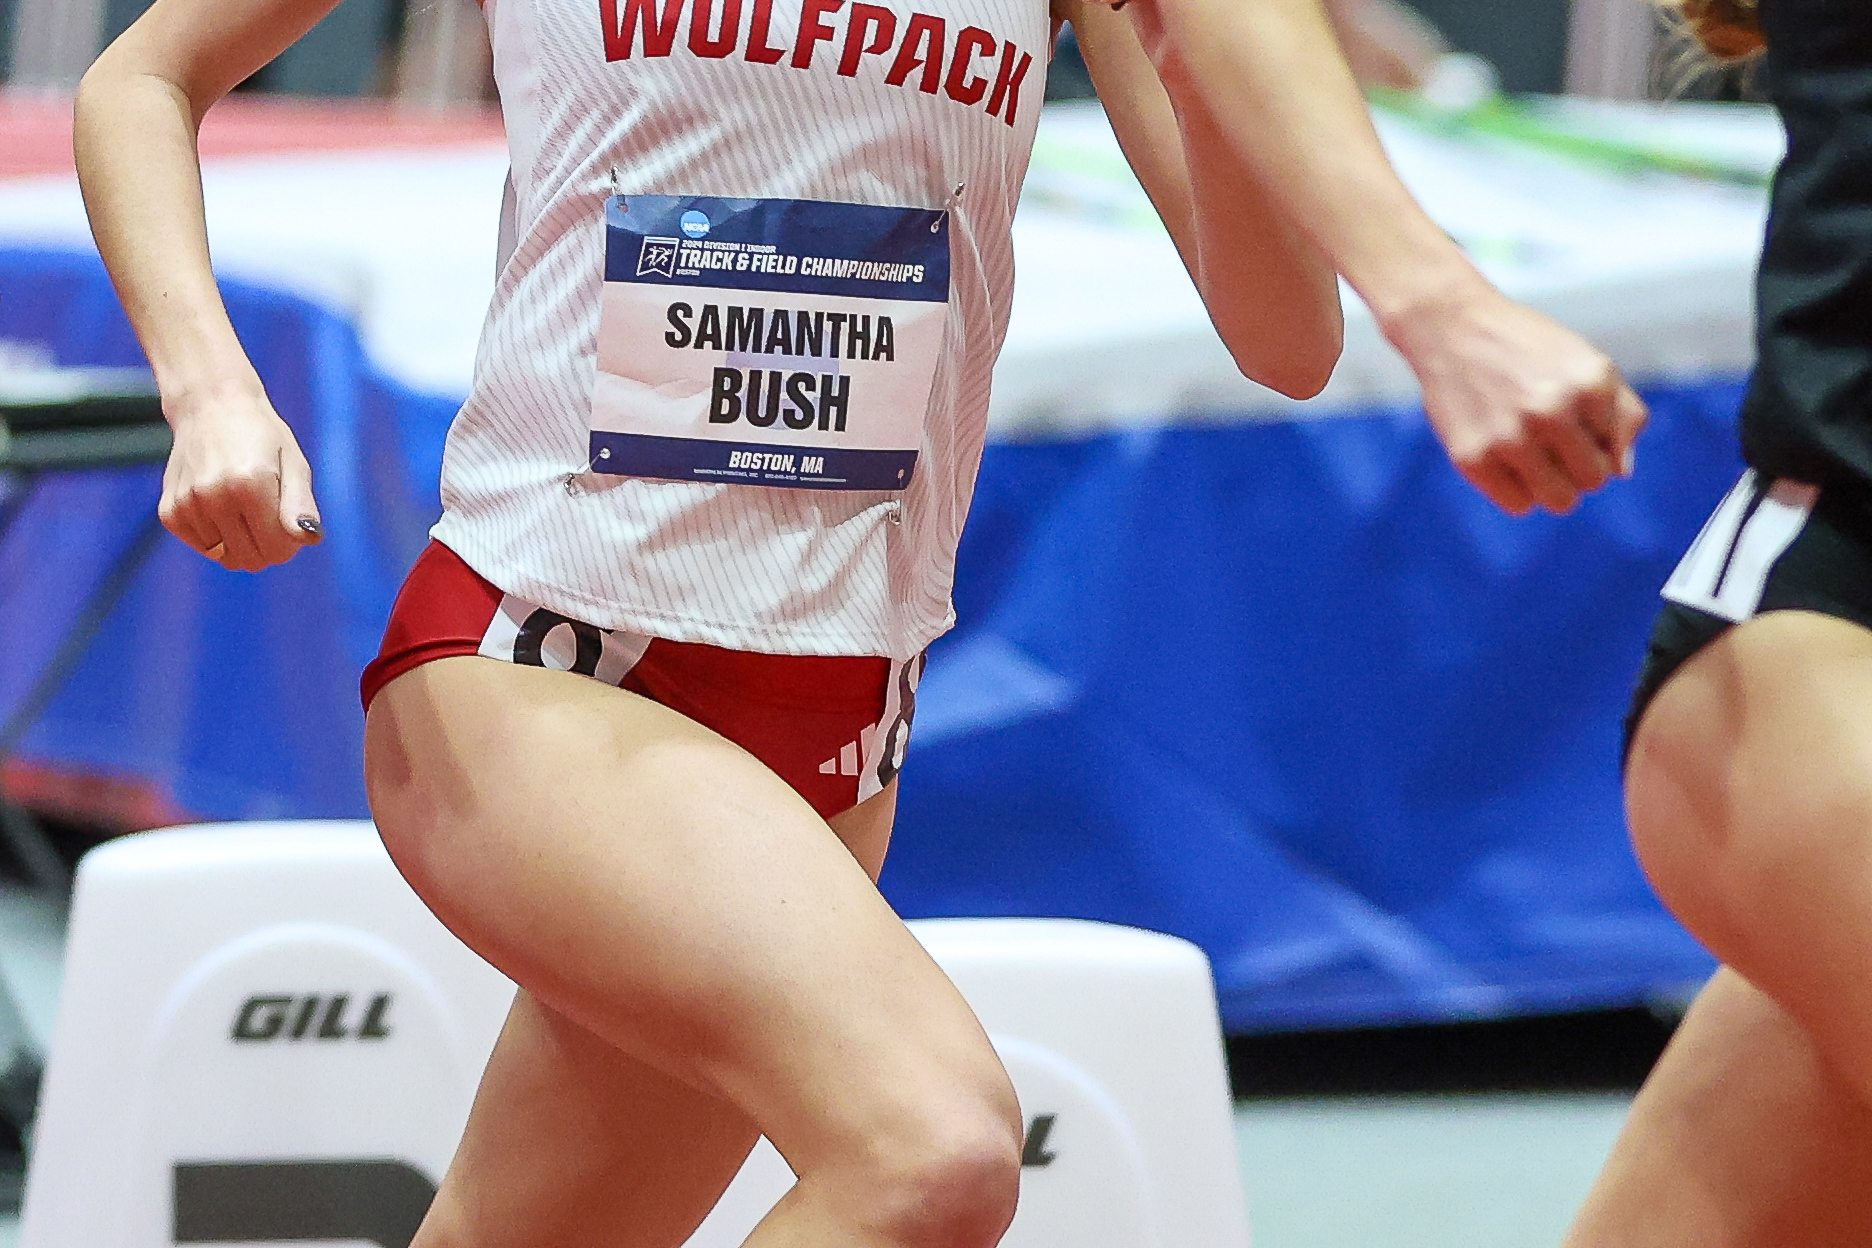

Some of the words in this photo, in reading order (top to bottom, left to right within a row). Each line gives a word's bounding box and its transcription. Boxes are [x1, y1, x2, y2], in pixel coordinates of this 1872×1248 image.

[679, 249, 733, 270] TRACK
[736, 254, 750, 271] &
[751, 254, 797, 275] FIELD
[801, 257, 925, 283] CHAMPIONSHIPS
[664, 301, 895, 362] SAMANTHA
[708, 367, 851, 432] BUSH
[729, 451, 796, 473] BOSTON,
[800, 456, 825, 474] MA
[231, 992, 392, 1040] GILL
